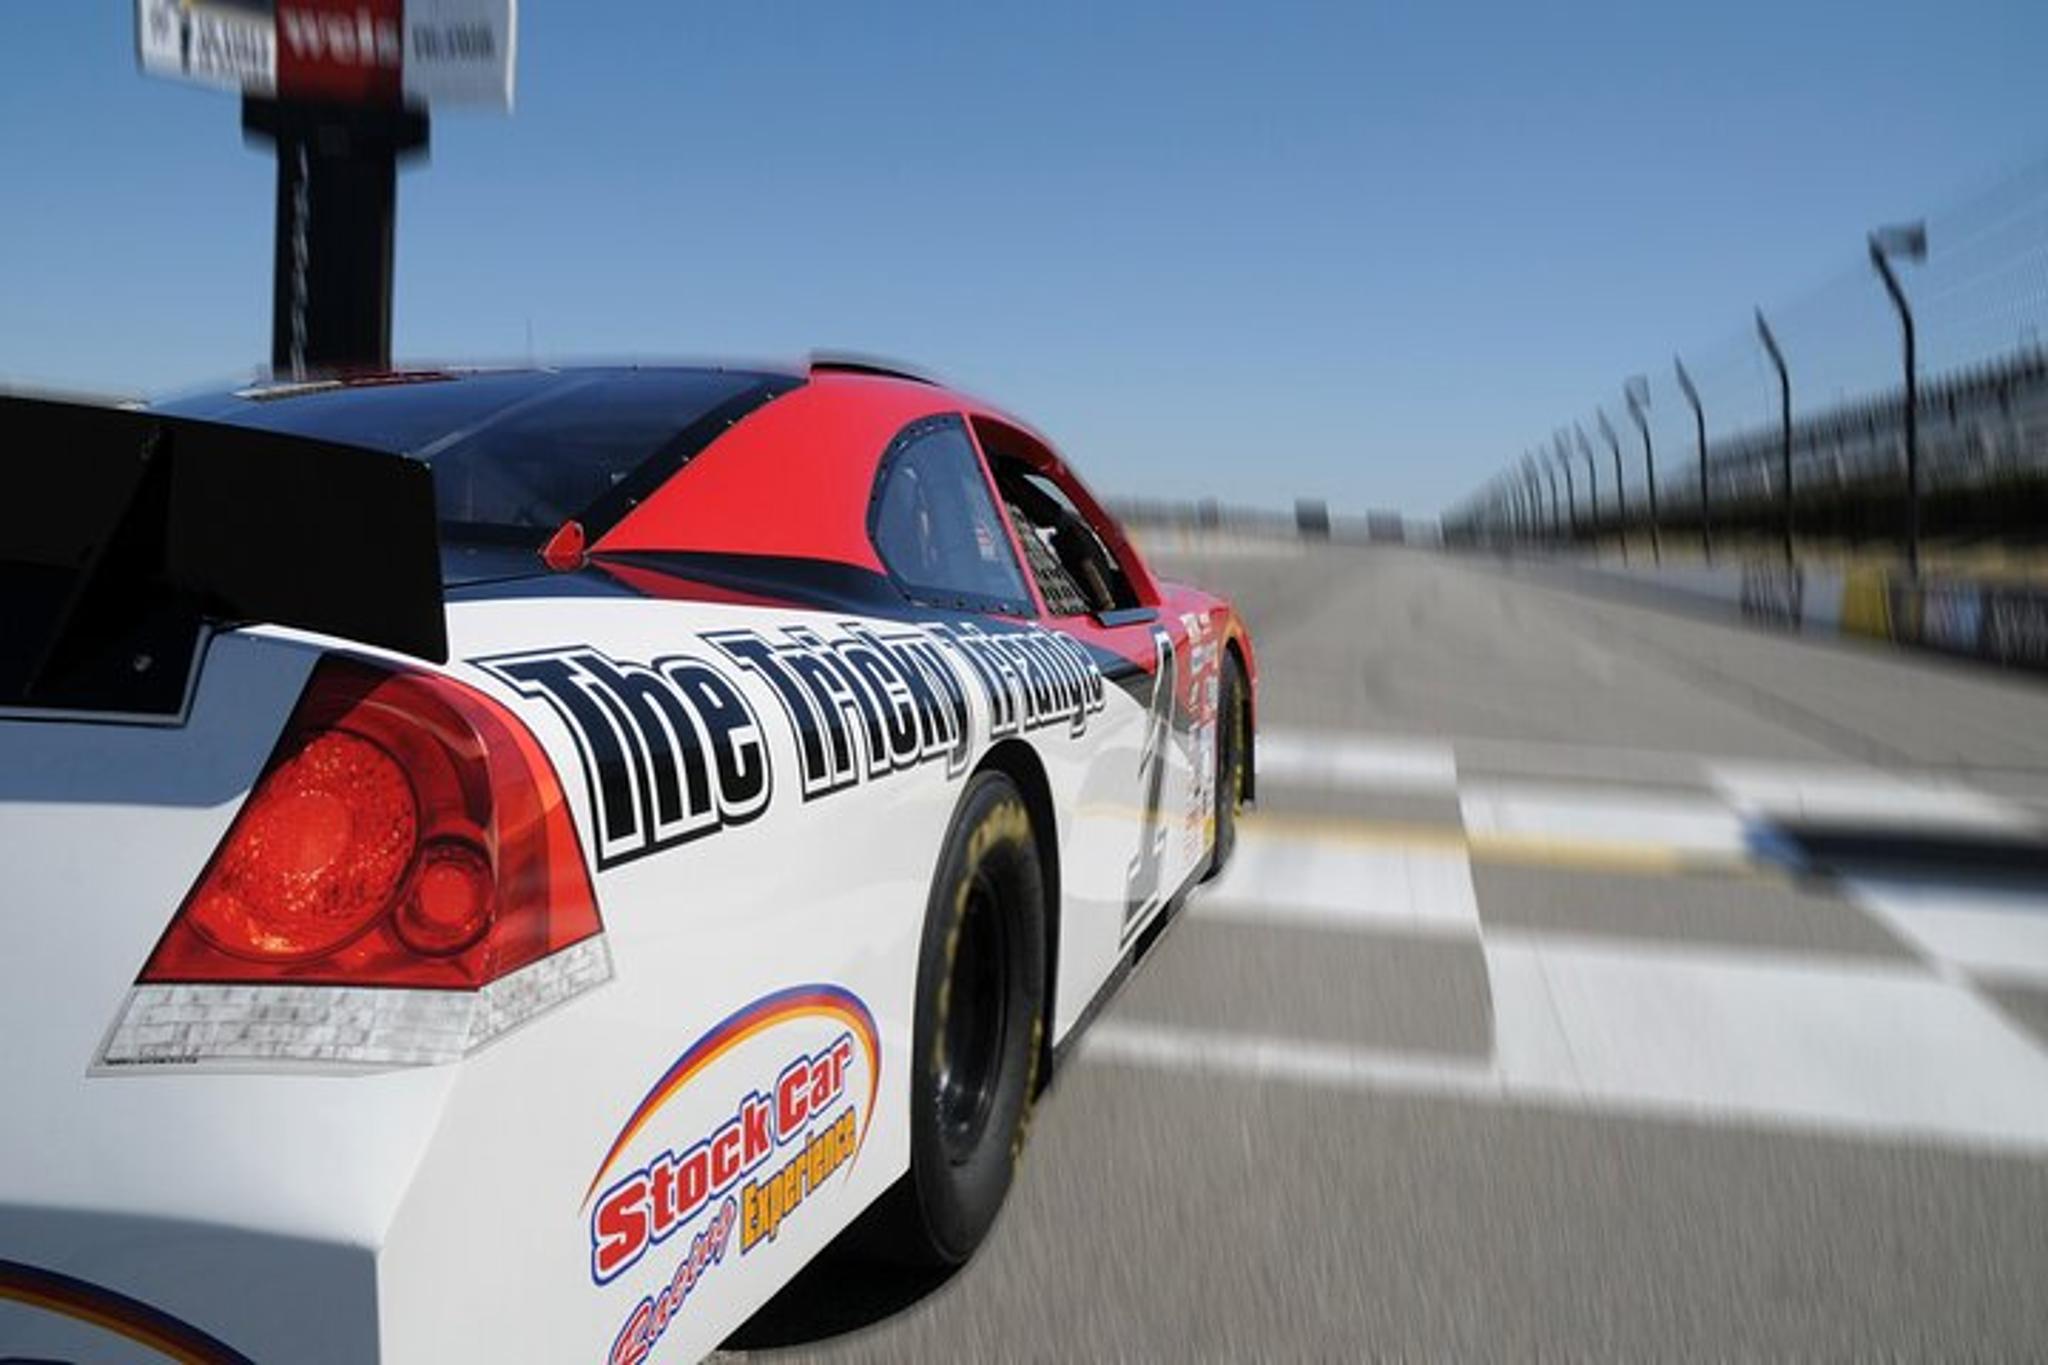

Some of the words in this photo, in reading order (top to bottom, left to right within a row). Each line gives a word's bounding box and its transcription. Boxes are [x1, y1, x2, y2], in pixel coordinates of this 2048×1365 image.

[472, 646, 771, 870] The
[702, 625, 972, 800] Tricky
[923, 623, 1105, 738] Triangle
[592, 1090, 774, 1285] Stock
[778, 1033, 854, 1146] Car
[740, 1107, 857, 1254] Experience
